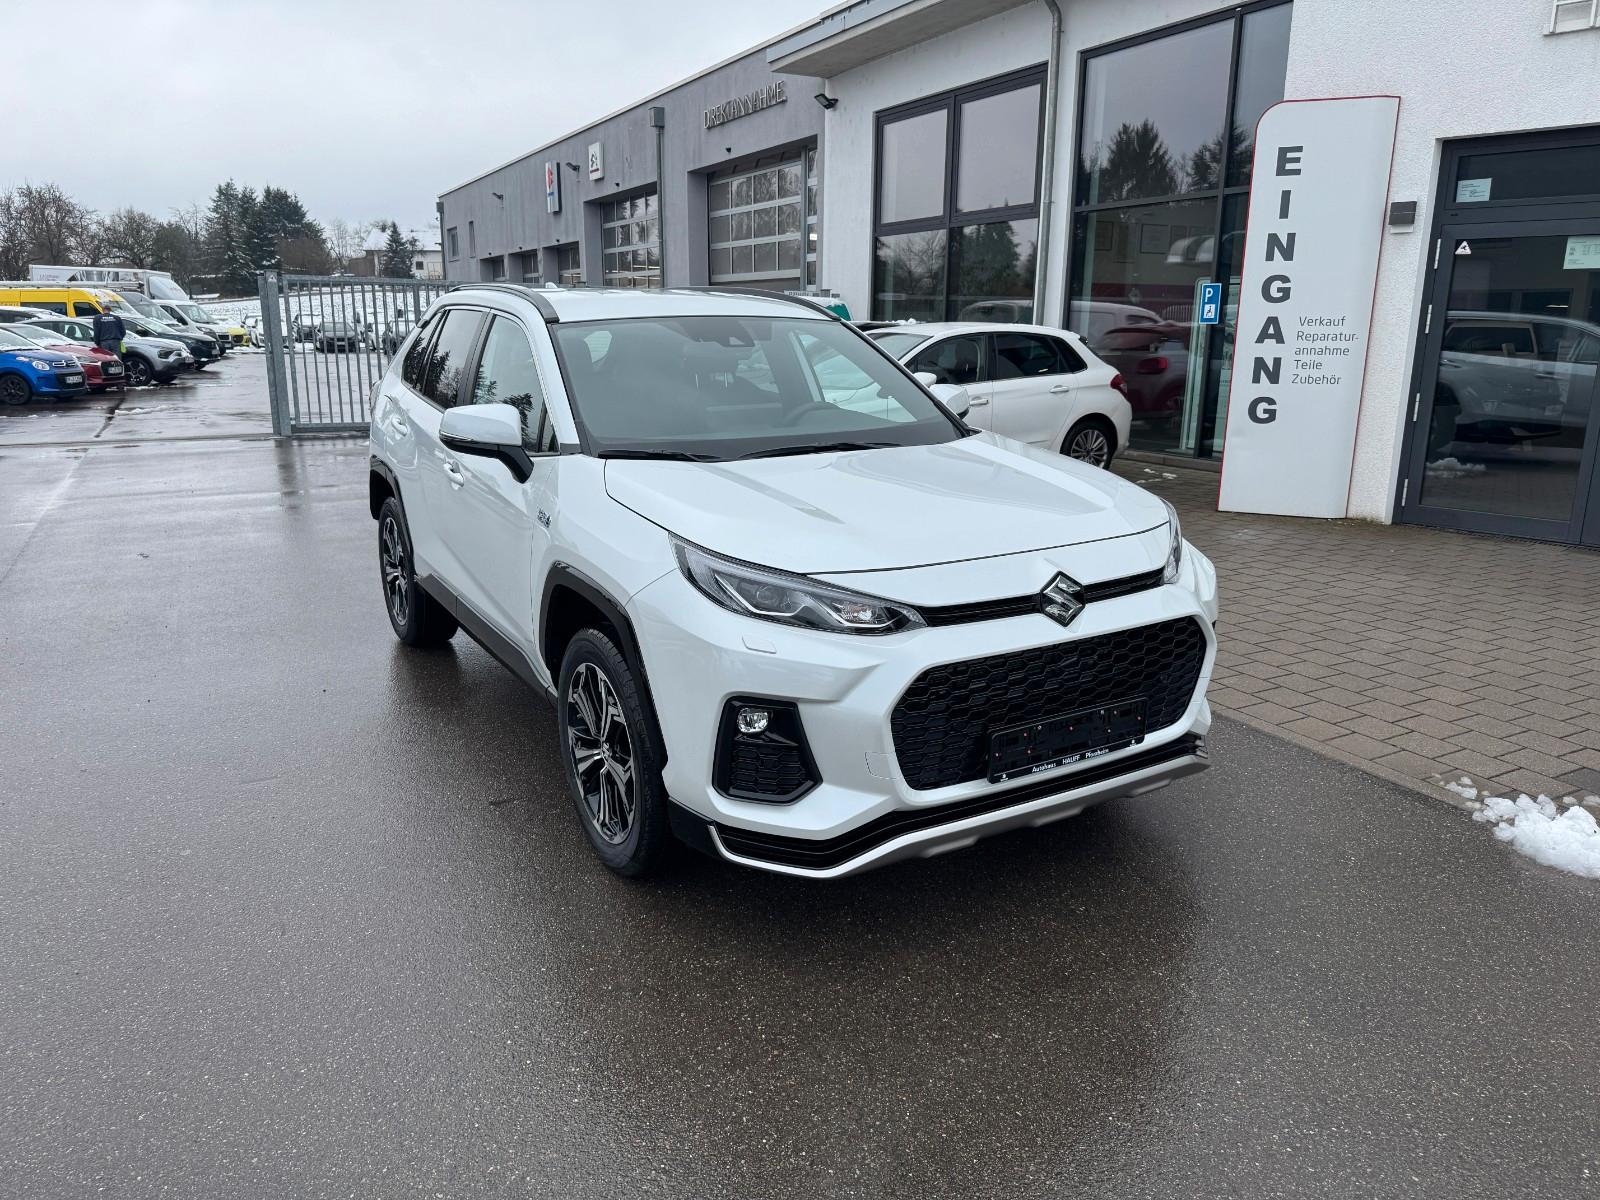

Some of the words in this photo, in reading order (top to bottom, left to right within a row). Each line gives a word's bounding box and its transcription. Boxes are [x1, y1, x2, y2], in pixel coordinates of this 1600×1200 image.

[1248, 145, 1303, 424] EINGANG
[1205, 287, 1214, 302] P
[1299, 315, 1346, 327] Verkauf
[1296, 330, 1359, 343] Reparatur-
[1294, 345, 1350, 356] annahme
[1294, 359, 1323, 370] Teile
[1291, 373, 1342, 385] Zubehör
[1032, 762, 1056, 773] Autohaus
